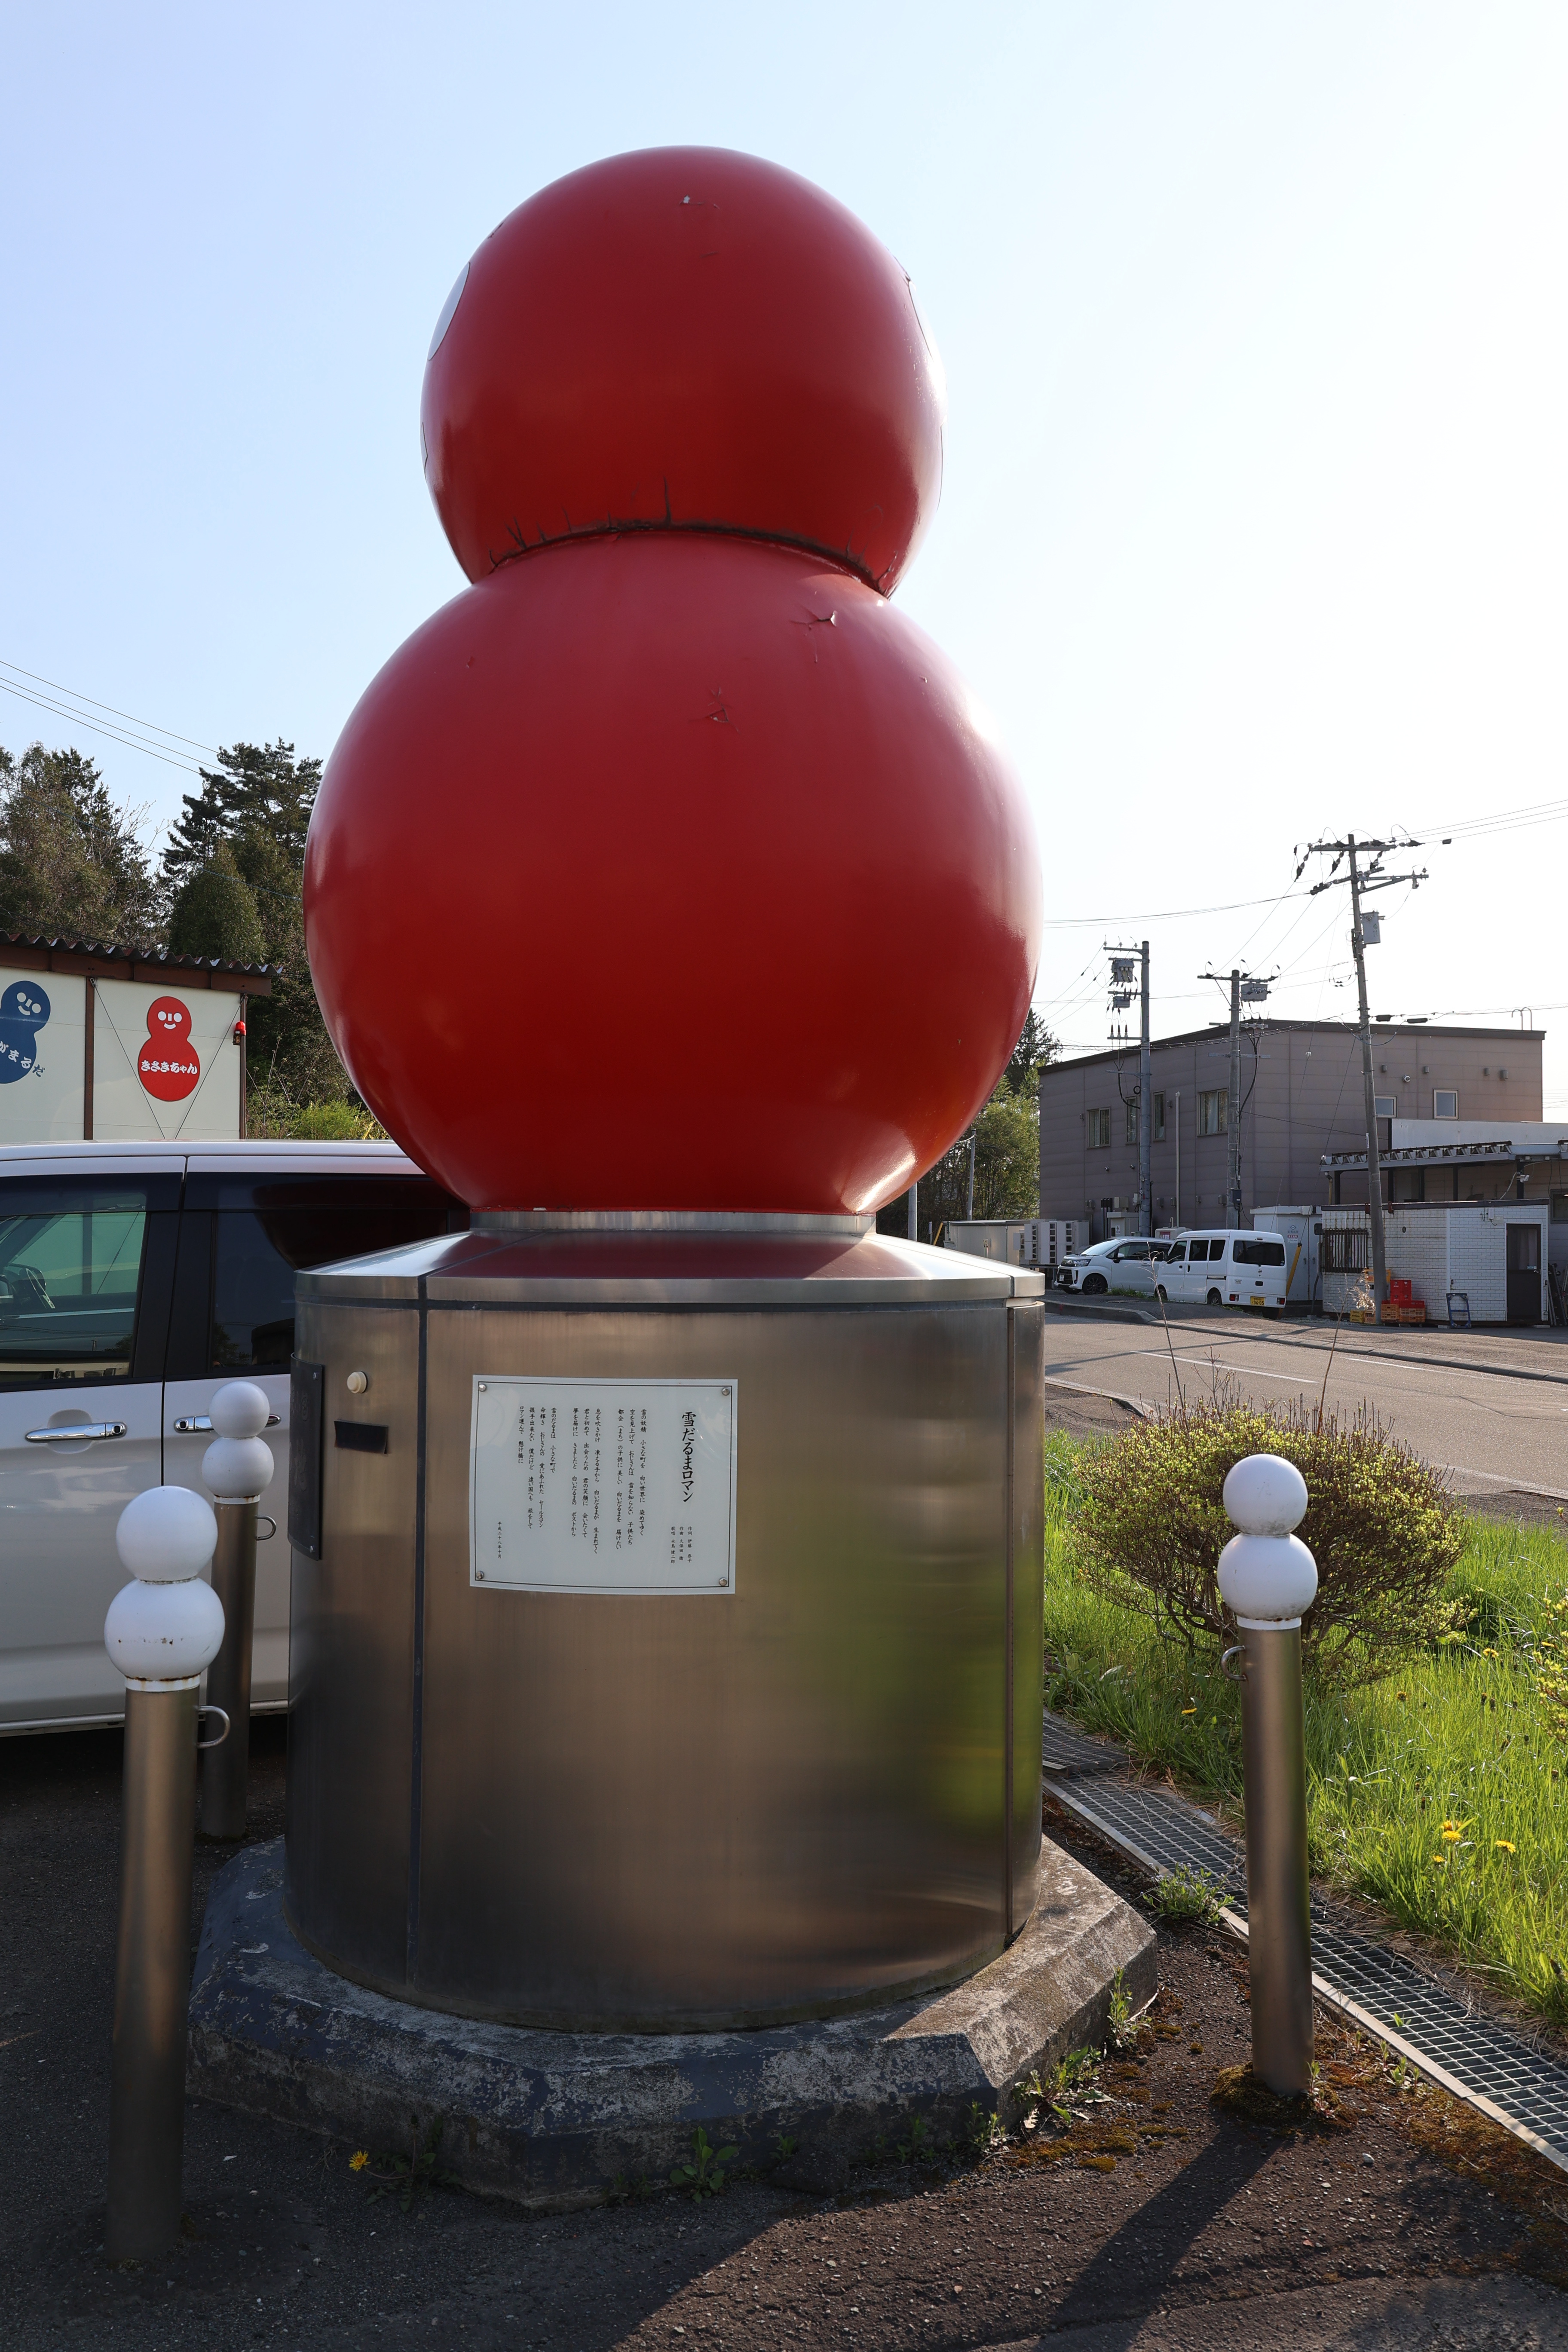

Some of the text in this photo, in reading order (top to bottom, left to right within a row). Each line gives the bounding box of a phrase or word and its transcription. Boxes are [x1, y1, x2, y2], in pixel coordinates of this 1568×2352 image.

[141, 1060, 198, 1075] きさきちゃん
[681, 1411, 697, 1503] 雪だるまロマン
[671, 1526, 676, 1536] 歌唱
[679, 1526, 684, 1536] 作曲
[687, 1526, 692, 1536] 作詞
[687, 1539, 692, 1549] 伊藤
